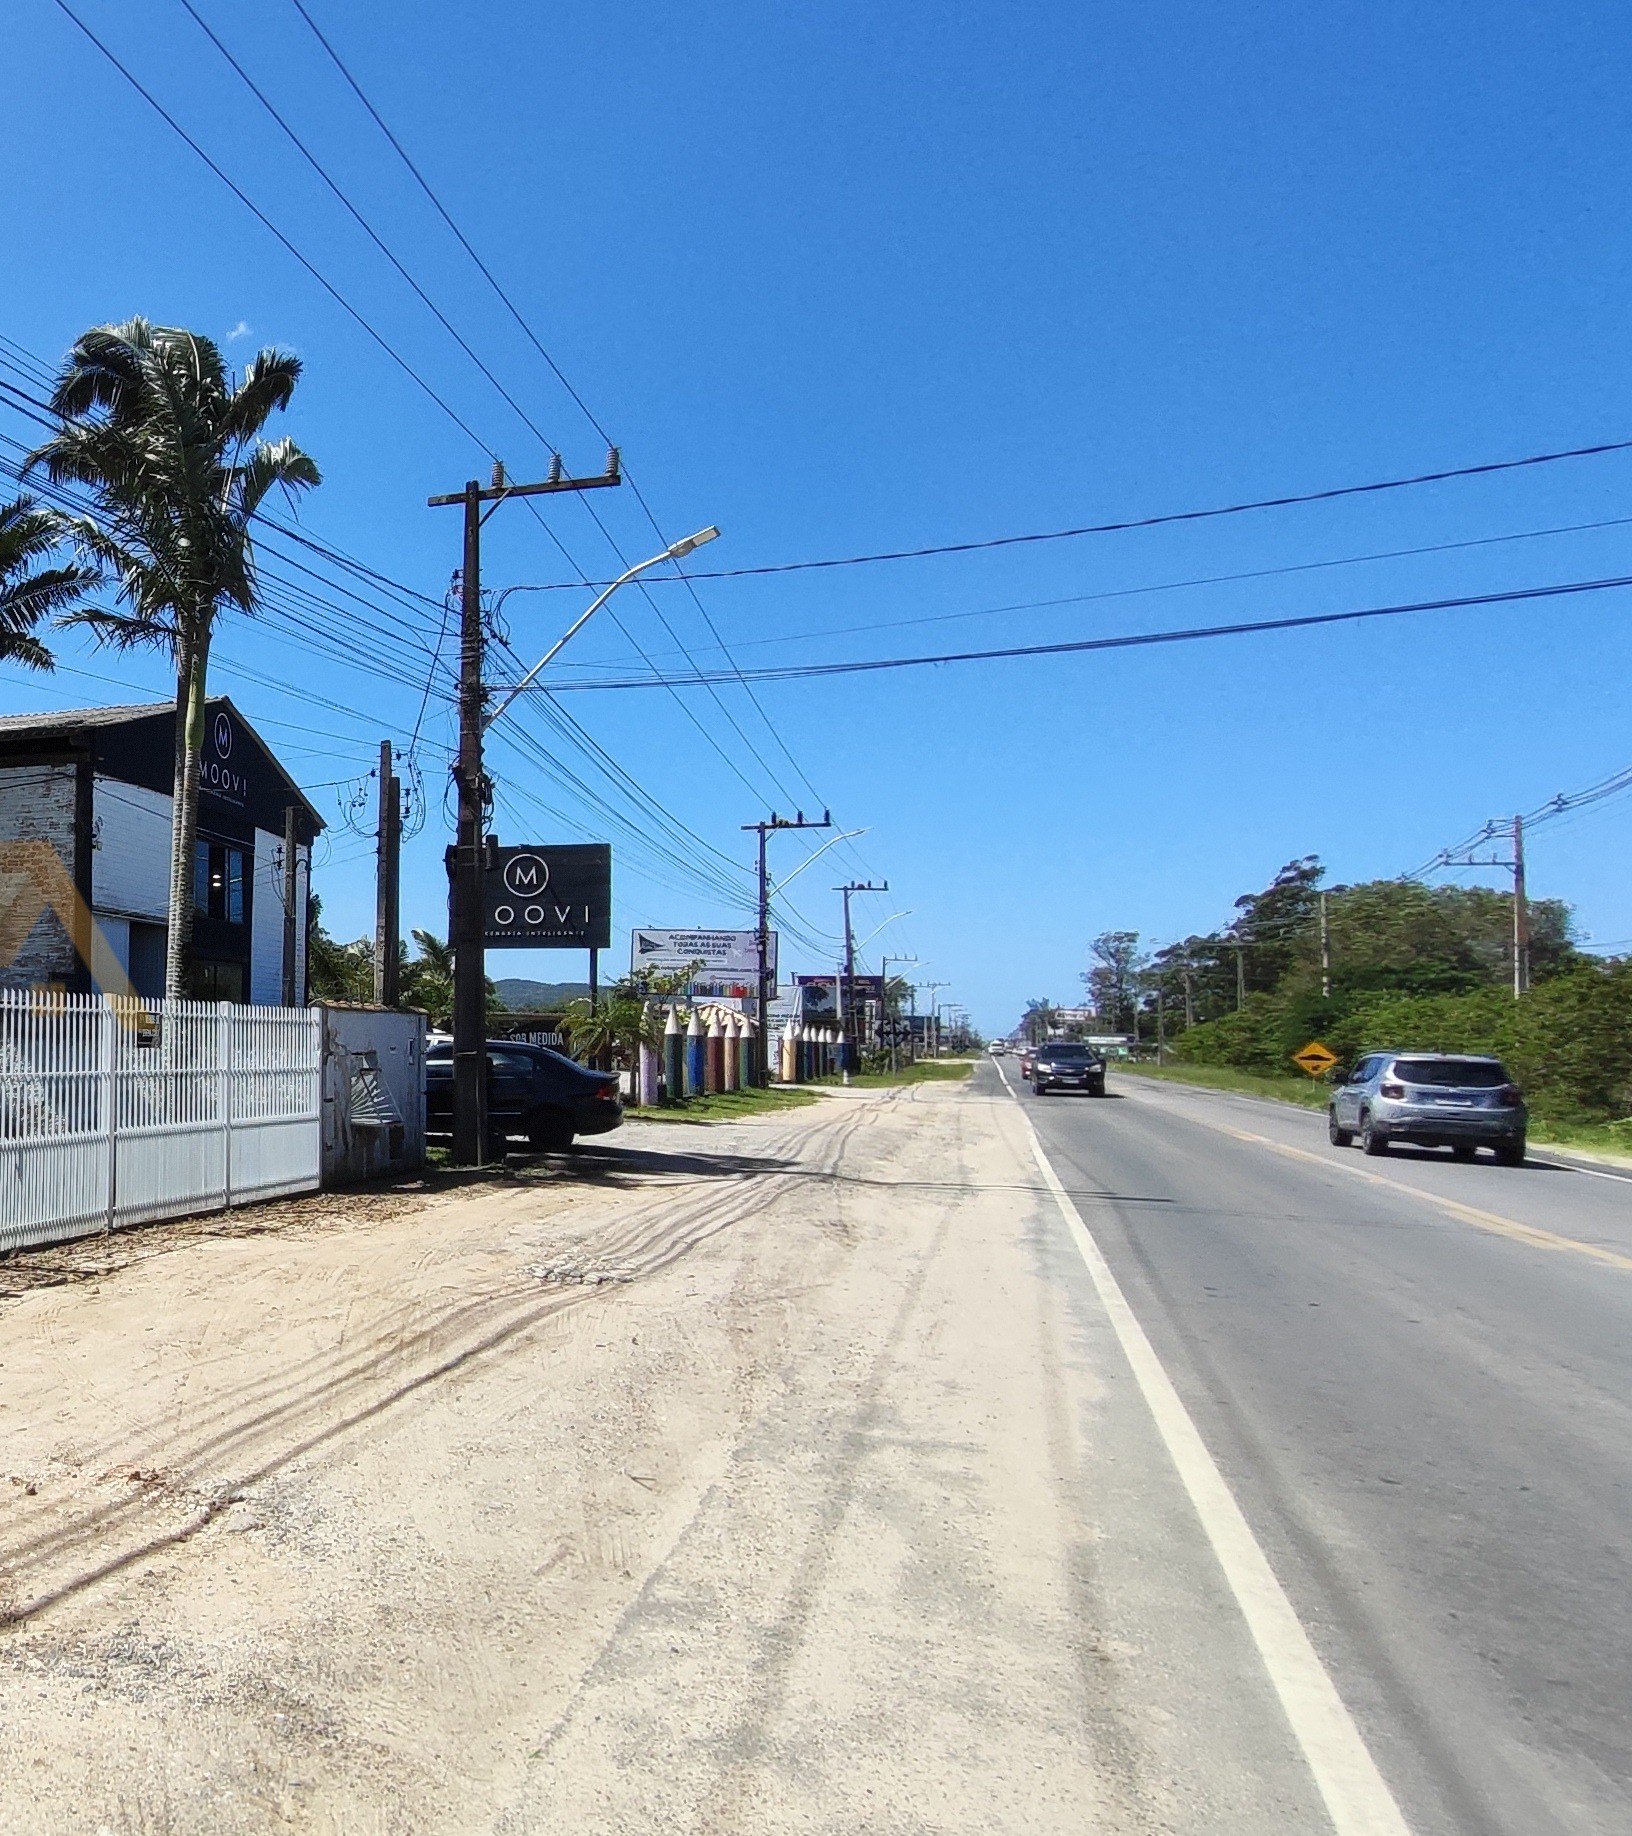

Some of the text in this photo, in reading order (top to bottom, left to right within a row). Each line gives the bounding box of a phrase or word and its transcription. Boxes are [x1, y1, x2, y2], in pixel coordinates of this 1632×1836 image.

[218, 724, 228, 748] M
[515, 866, 538, 885] M
[494, 905, 590, 925] OOVI
[668, 934, 737, 942] ACOMPANHANDO
[676, 948, 728, 956] CONQUISTAS
[529, 1032, 564, 1046] MEDIDA
